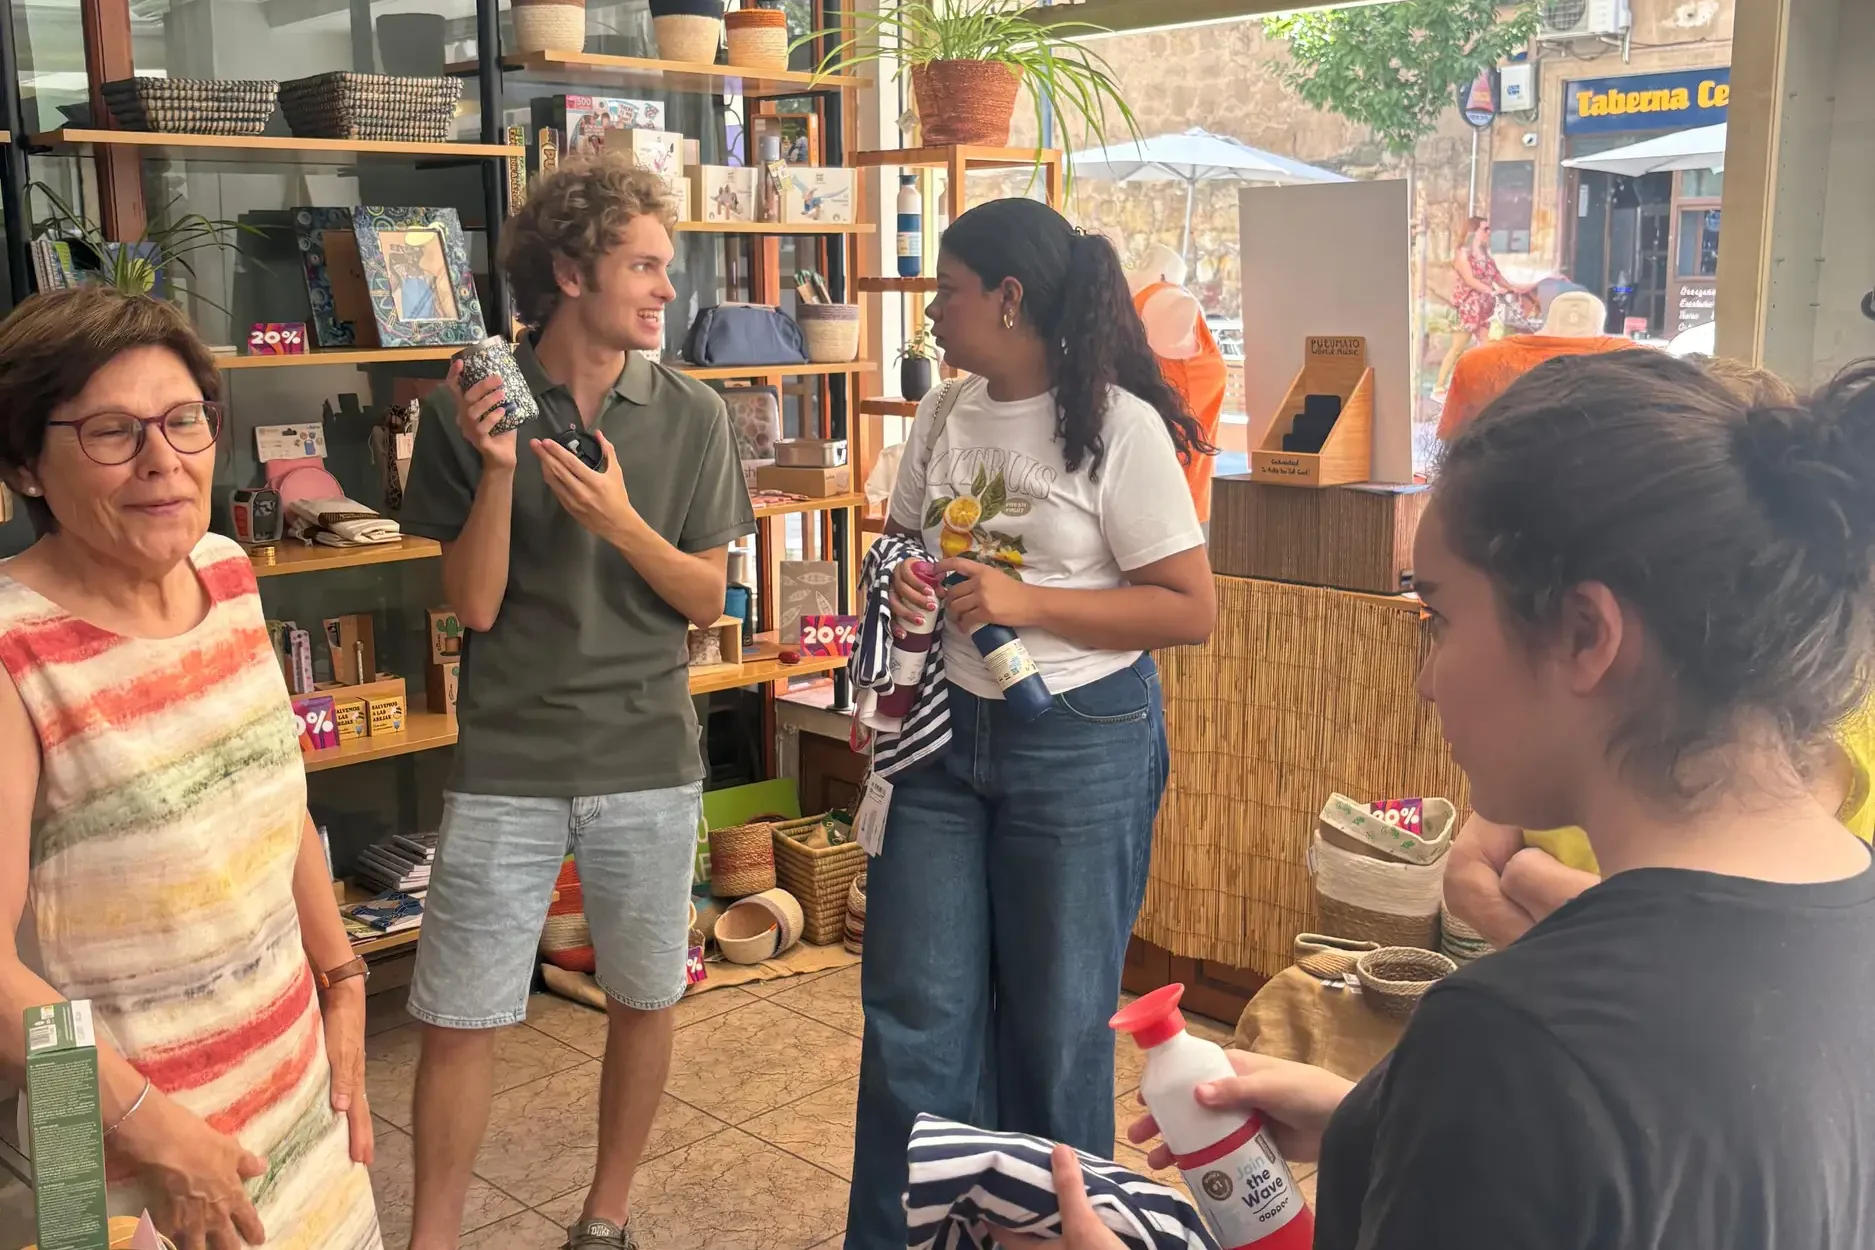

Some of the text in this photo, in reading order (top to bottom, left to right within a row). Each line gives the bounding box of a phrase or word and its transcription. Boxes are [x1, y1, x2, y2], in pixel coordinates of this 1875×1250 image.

[1576, 87, 1690, 117] Taberna
[251, 331, 301, 344] 20%
[926, 446, 1057, 500] CITRUS
[803, 625, 856, 644] 20%
[336, 706, 360, 714] ALVEMOS
[371, 701, 398, 710] SALVEMOS
[1236, 1155, 1266, 1180] Join
[1246, 1169, 1271, 1190] the
[1241, 1177, 1283, 1208] Wave
[1258, 1197, 1289, 1222] dopper
